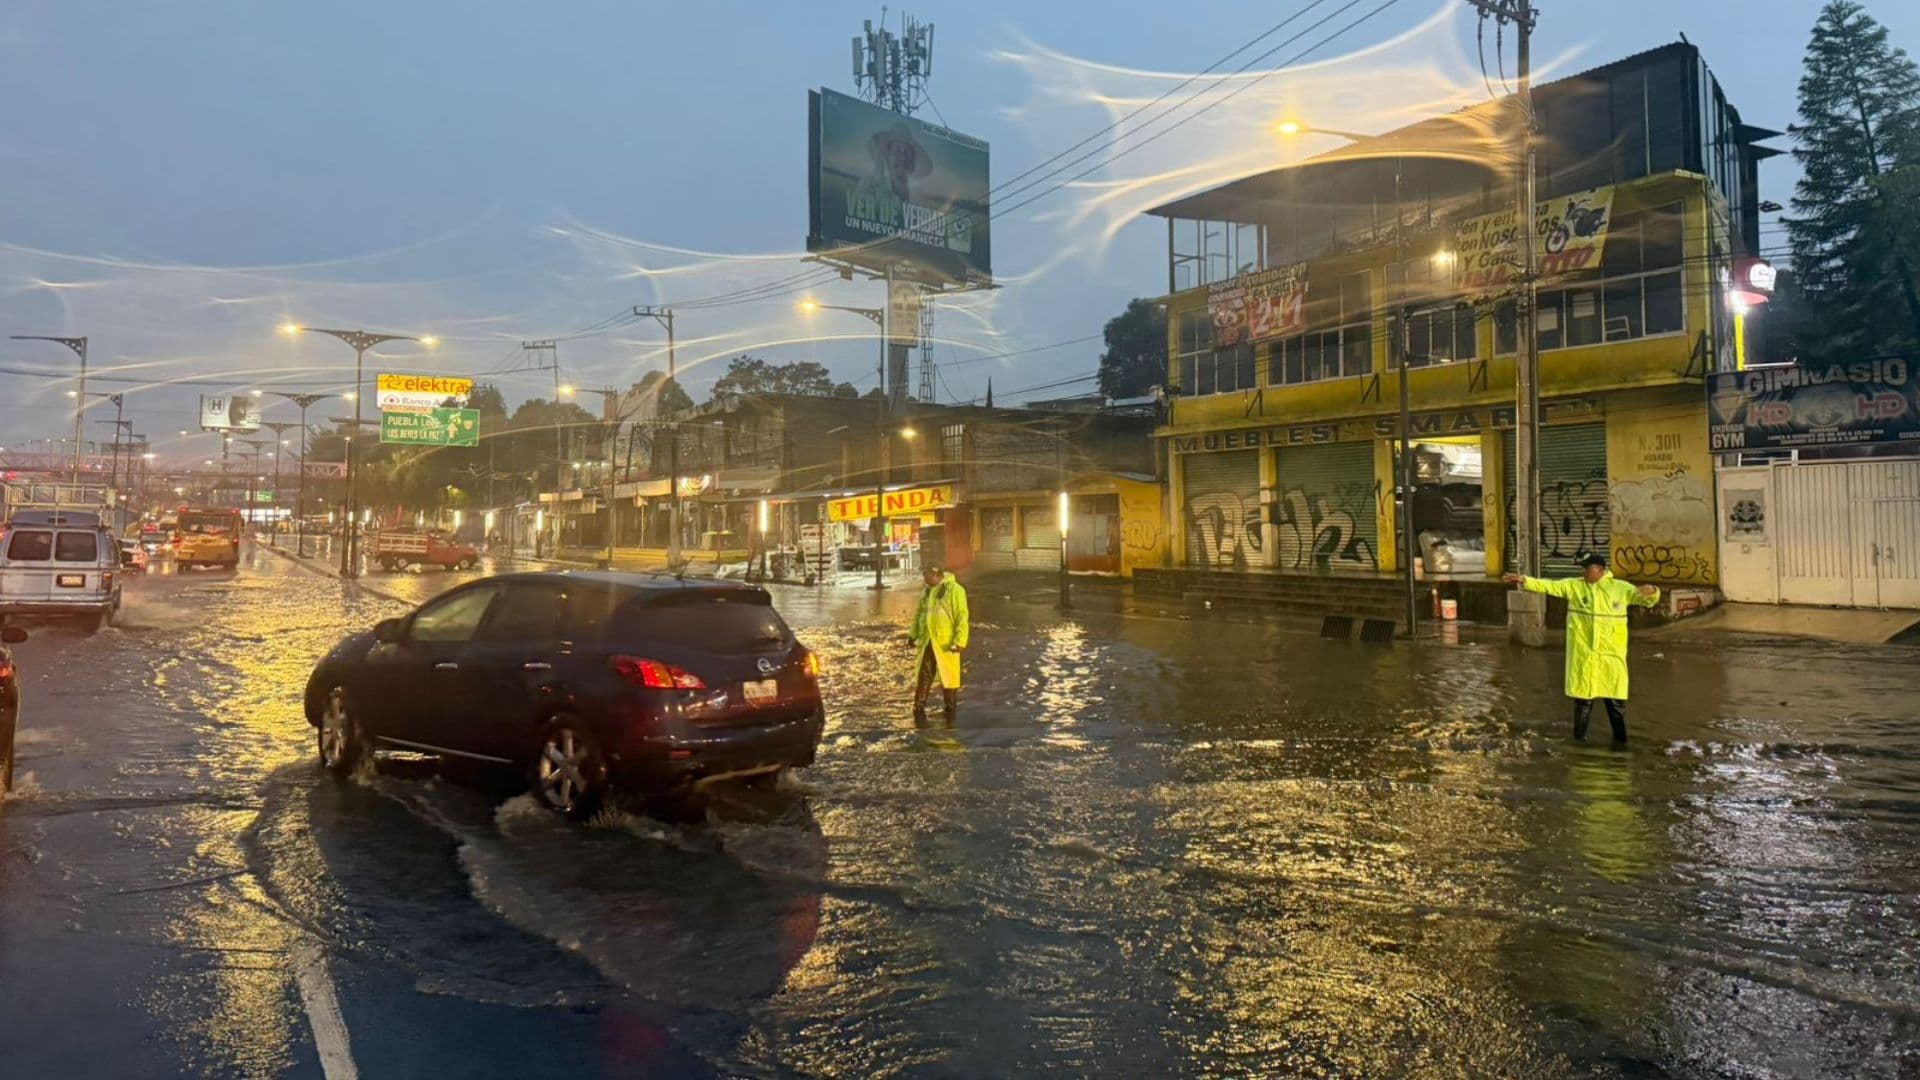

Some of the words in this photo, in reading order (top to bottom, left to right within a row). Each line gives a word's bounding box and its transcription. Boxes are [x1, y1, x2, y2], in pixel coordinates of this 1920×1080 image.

[845, 216, 860, 229] UN
[862, 220, 895, 236] NUEVO
[404, 377, 466, 393] elektra
[1748, 401, 1794, 425] HD
[1856, 390, 1909, 420] HD
[388, 416, 419, 427] PUEBLA
[1175, 424, 1330, 451] MUEBLES
[1656, 433, 1681, 450] 3011
[1713, 432, 1745, 449] GYM
[838, 489, 945, 517] TIENDA
